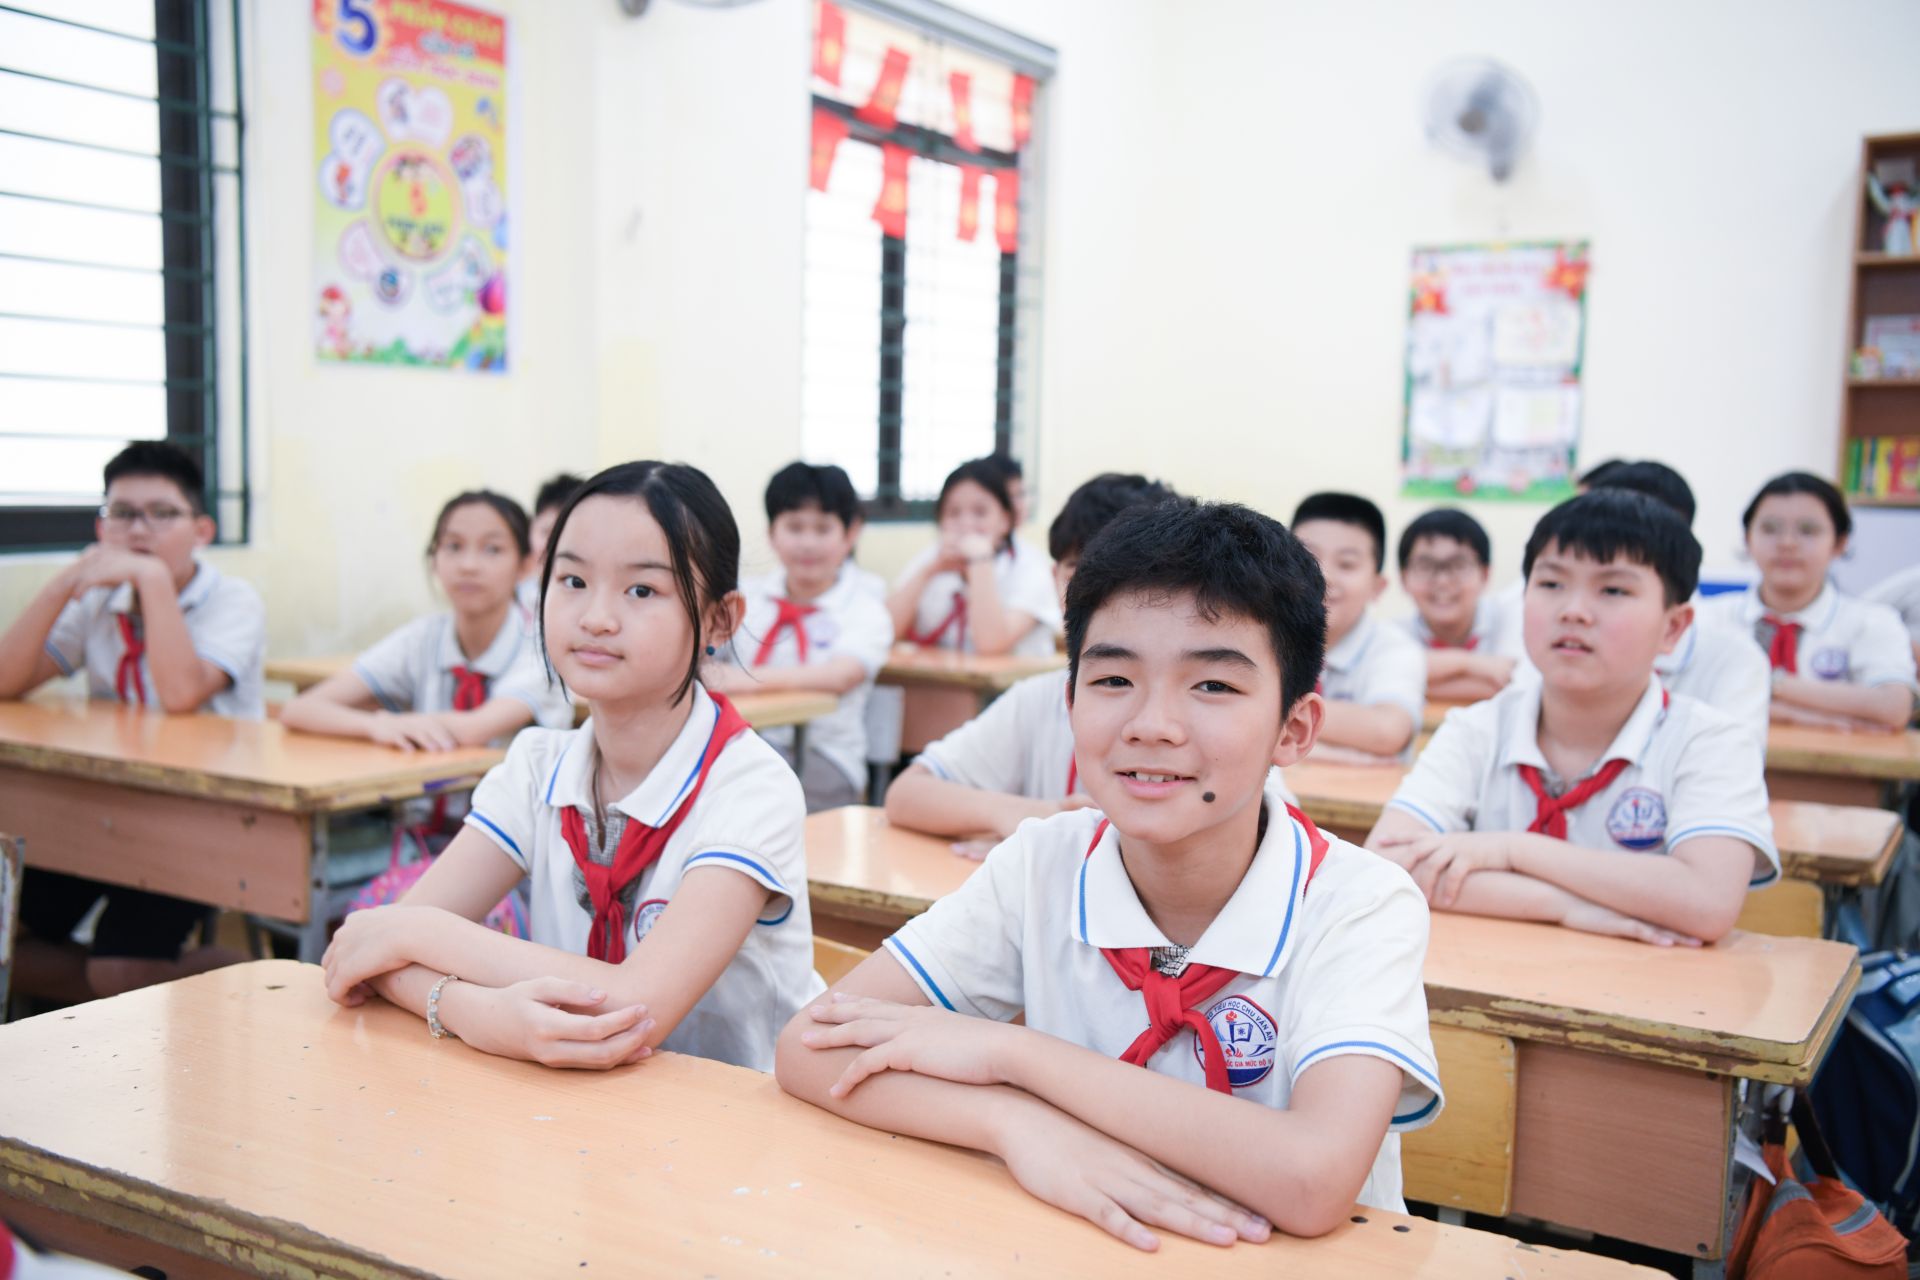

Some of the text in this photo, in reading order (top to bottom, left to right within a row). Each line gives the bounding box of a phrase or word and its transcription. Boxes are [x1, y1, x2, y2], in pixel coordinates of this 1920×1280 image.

[336, 0, 378, 53] 5
[1228, 1001, 1241, 1009] HỌC
[1241, 1004, 1256, 1017] CHU
[1265, 1031, 1274, 1041] AN
